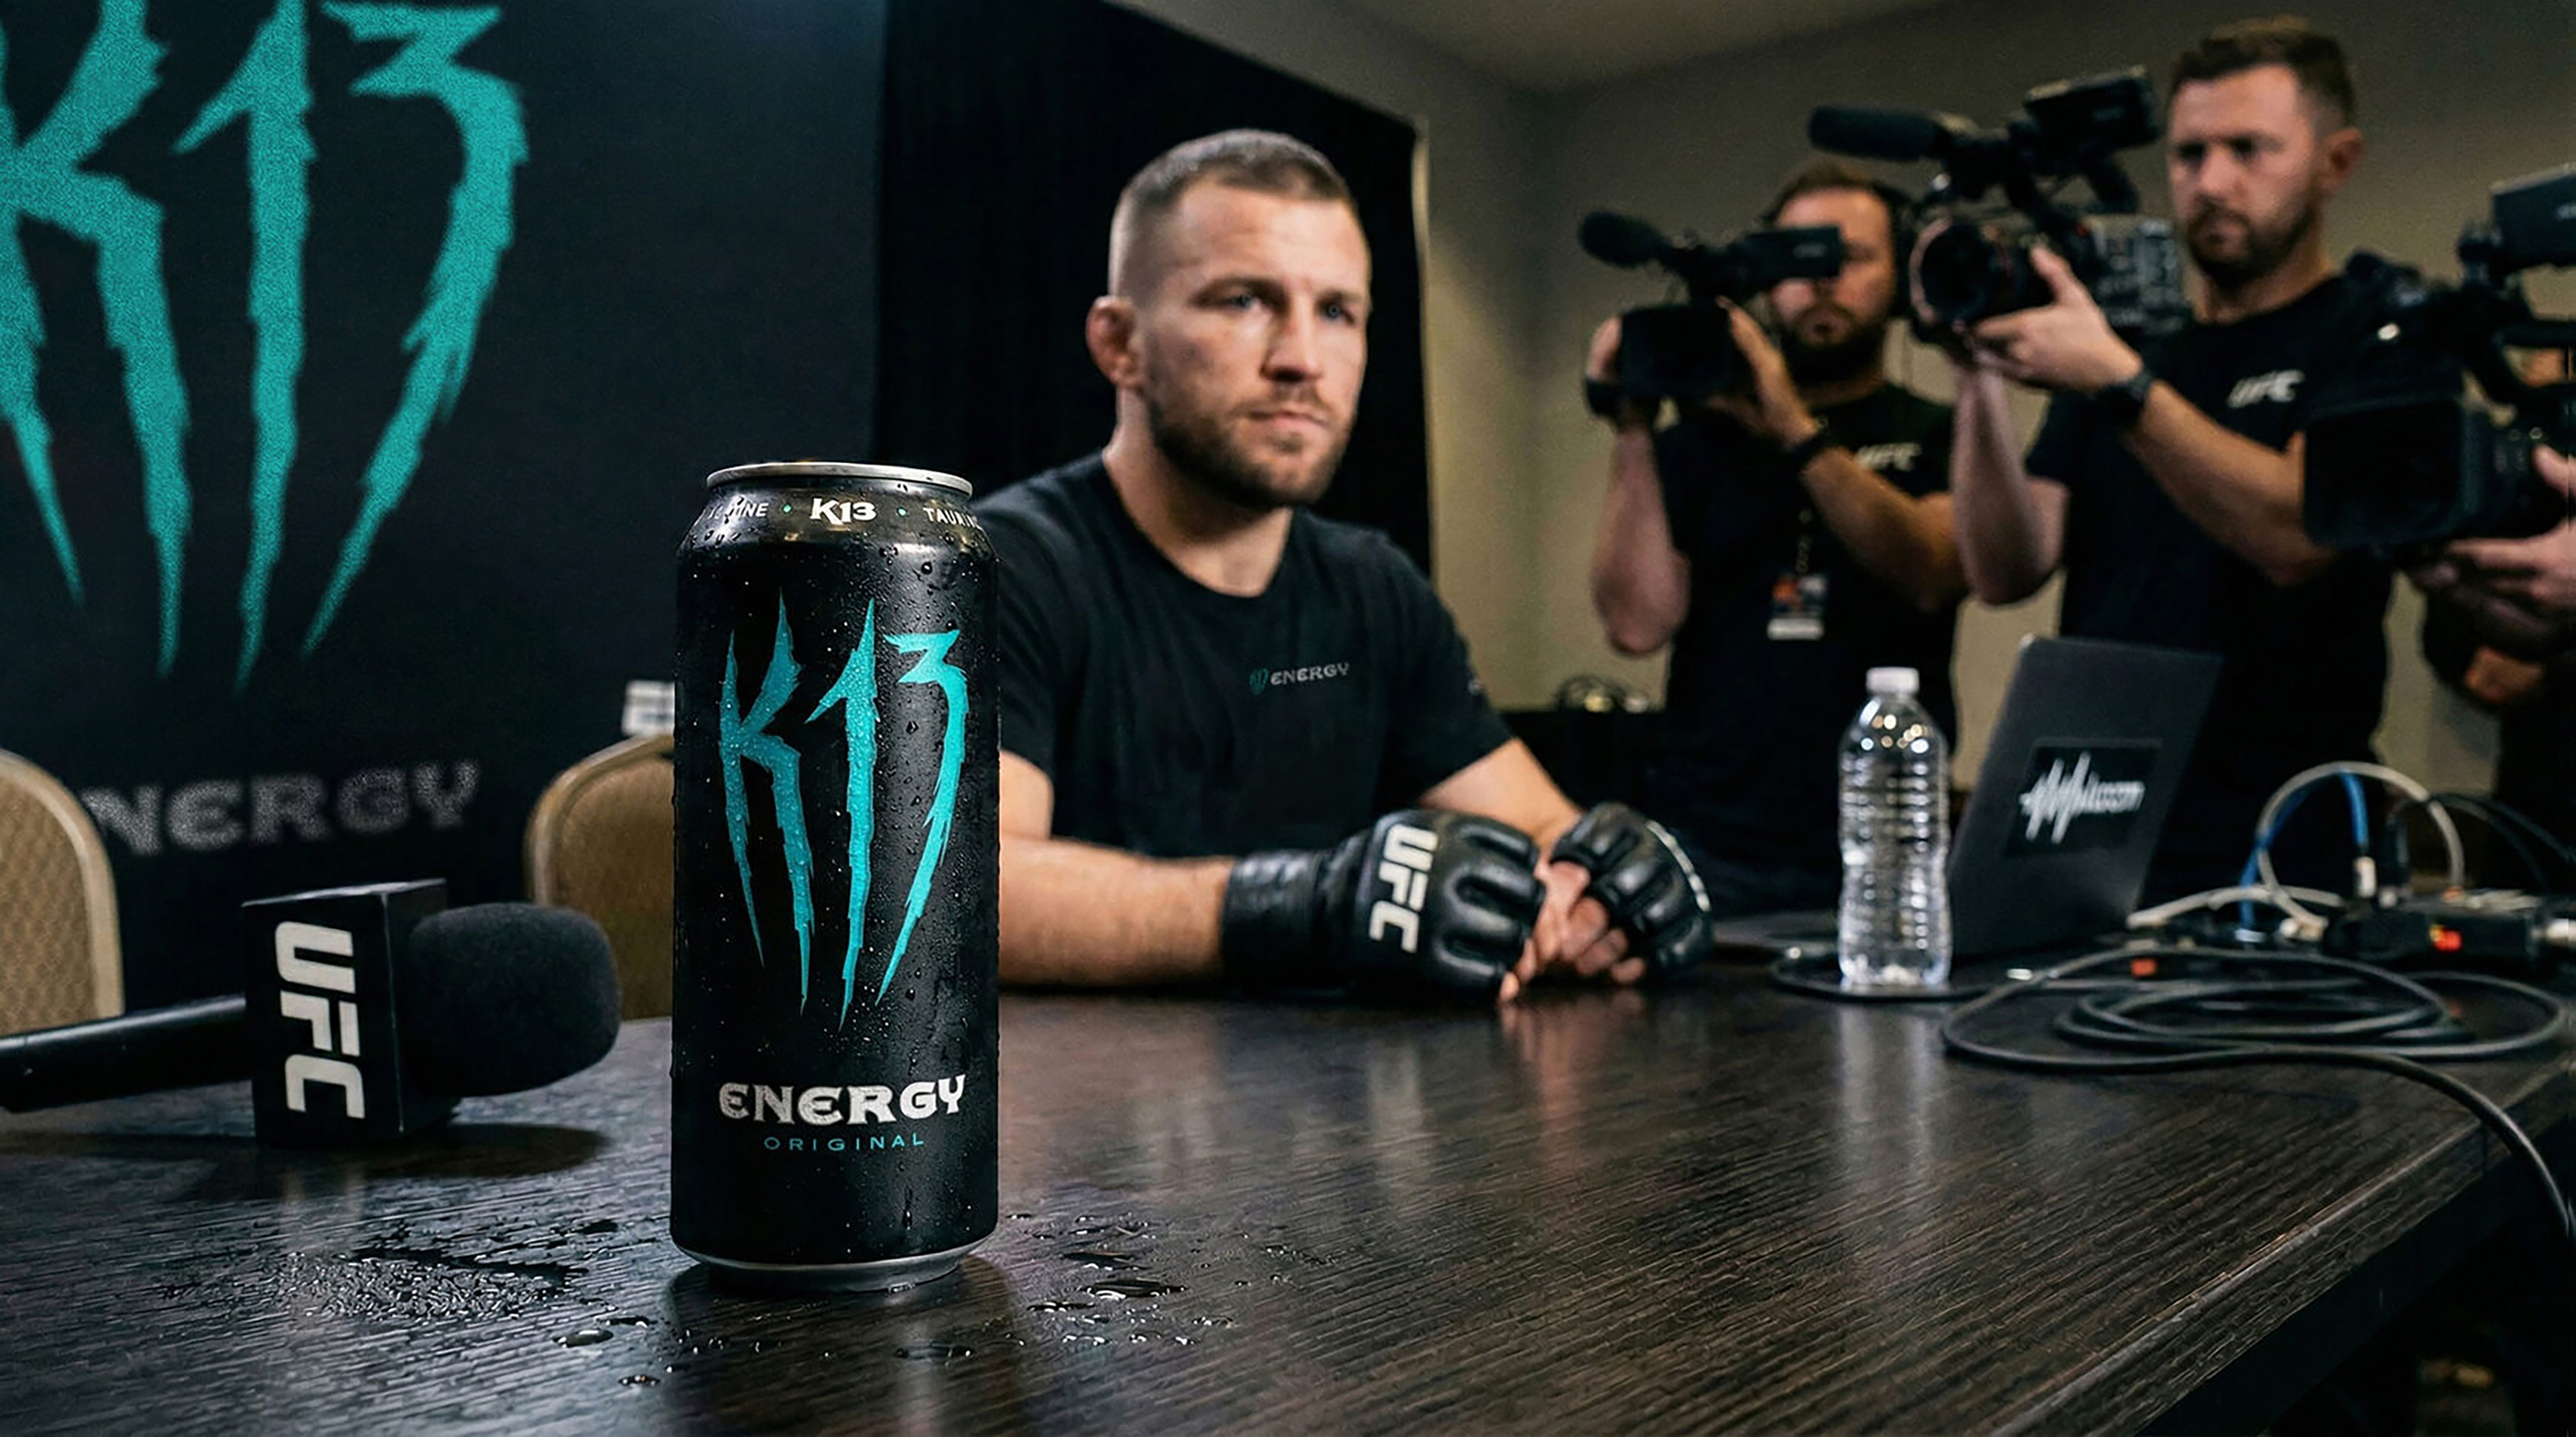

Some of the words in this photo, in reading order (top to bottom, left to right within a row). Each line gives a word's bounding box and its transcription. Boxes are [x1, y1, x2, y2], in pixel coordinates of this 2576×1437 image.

[810, 497, 877, 527] K13
[1270, 662, 1350, 686] ENERGY
[81, 759, 481, 856] NERGY
[719, 587, 971, 1032] K13
[1370, 825, 1438, 953] UFC
[275, 922, 365, 1119] UFC
[719, 1074, 966, 1126] ENERGY
[763, 1132, 925, 1152] ORIGINAL
